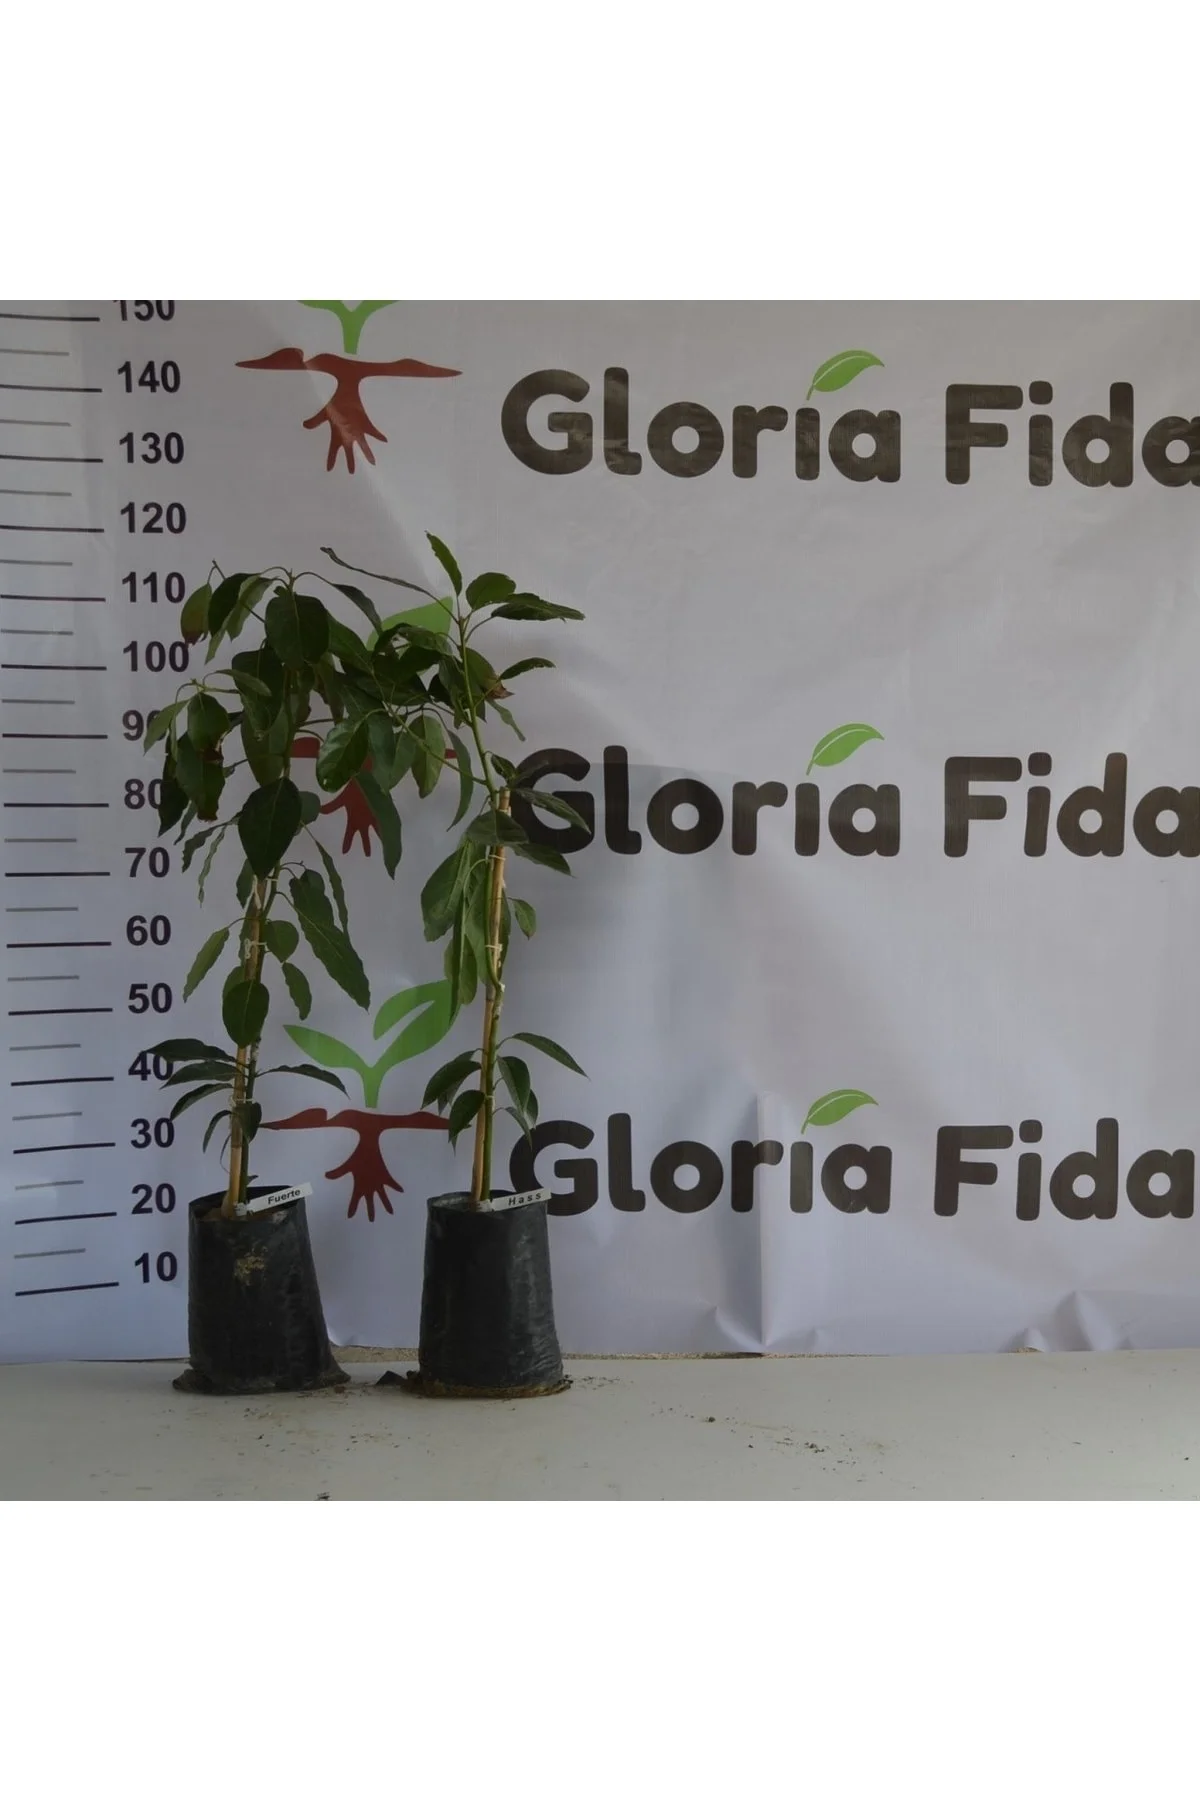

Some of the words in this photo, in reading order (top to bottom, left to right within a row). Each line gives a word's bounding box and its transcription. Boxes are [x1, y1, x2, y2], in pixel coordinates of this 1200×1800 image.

[112, 300, 175, 321] 150
[117, 361, 181, 393] 140
[501, 366, 901, 483] Gloria
[945, 380, 1200, 488] Fida
[119, 432, 185, 464] 130
[120, 502, 187, 534] 120
[121, 571, 186, 603] 110
[122, 641, 190, 673] 100
[943, 752, 1200, 858] Fida
[125, 847, 170, 878] 70
[126, 914, 172, 946] 60
[127, 983, 173, 1014] 50
[128, 1050, 174, 1081] 40
[130, 1117, 175, 1149] 30
[934, 1117, 1195, 1221] Fida
[131, 1183, 177, 1214] 20
[267, 1188, 302, 1205] Fuerte
[508, 1192, 542, 1206] Hass
[134, 1251, 178, 1283] 10
